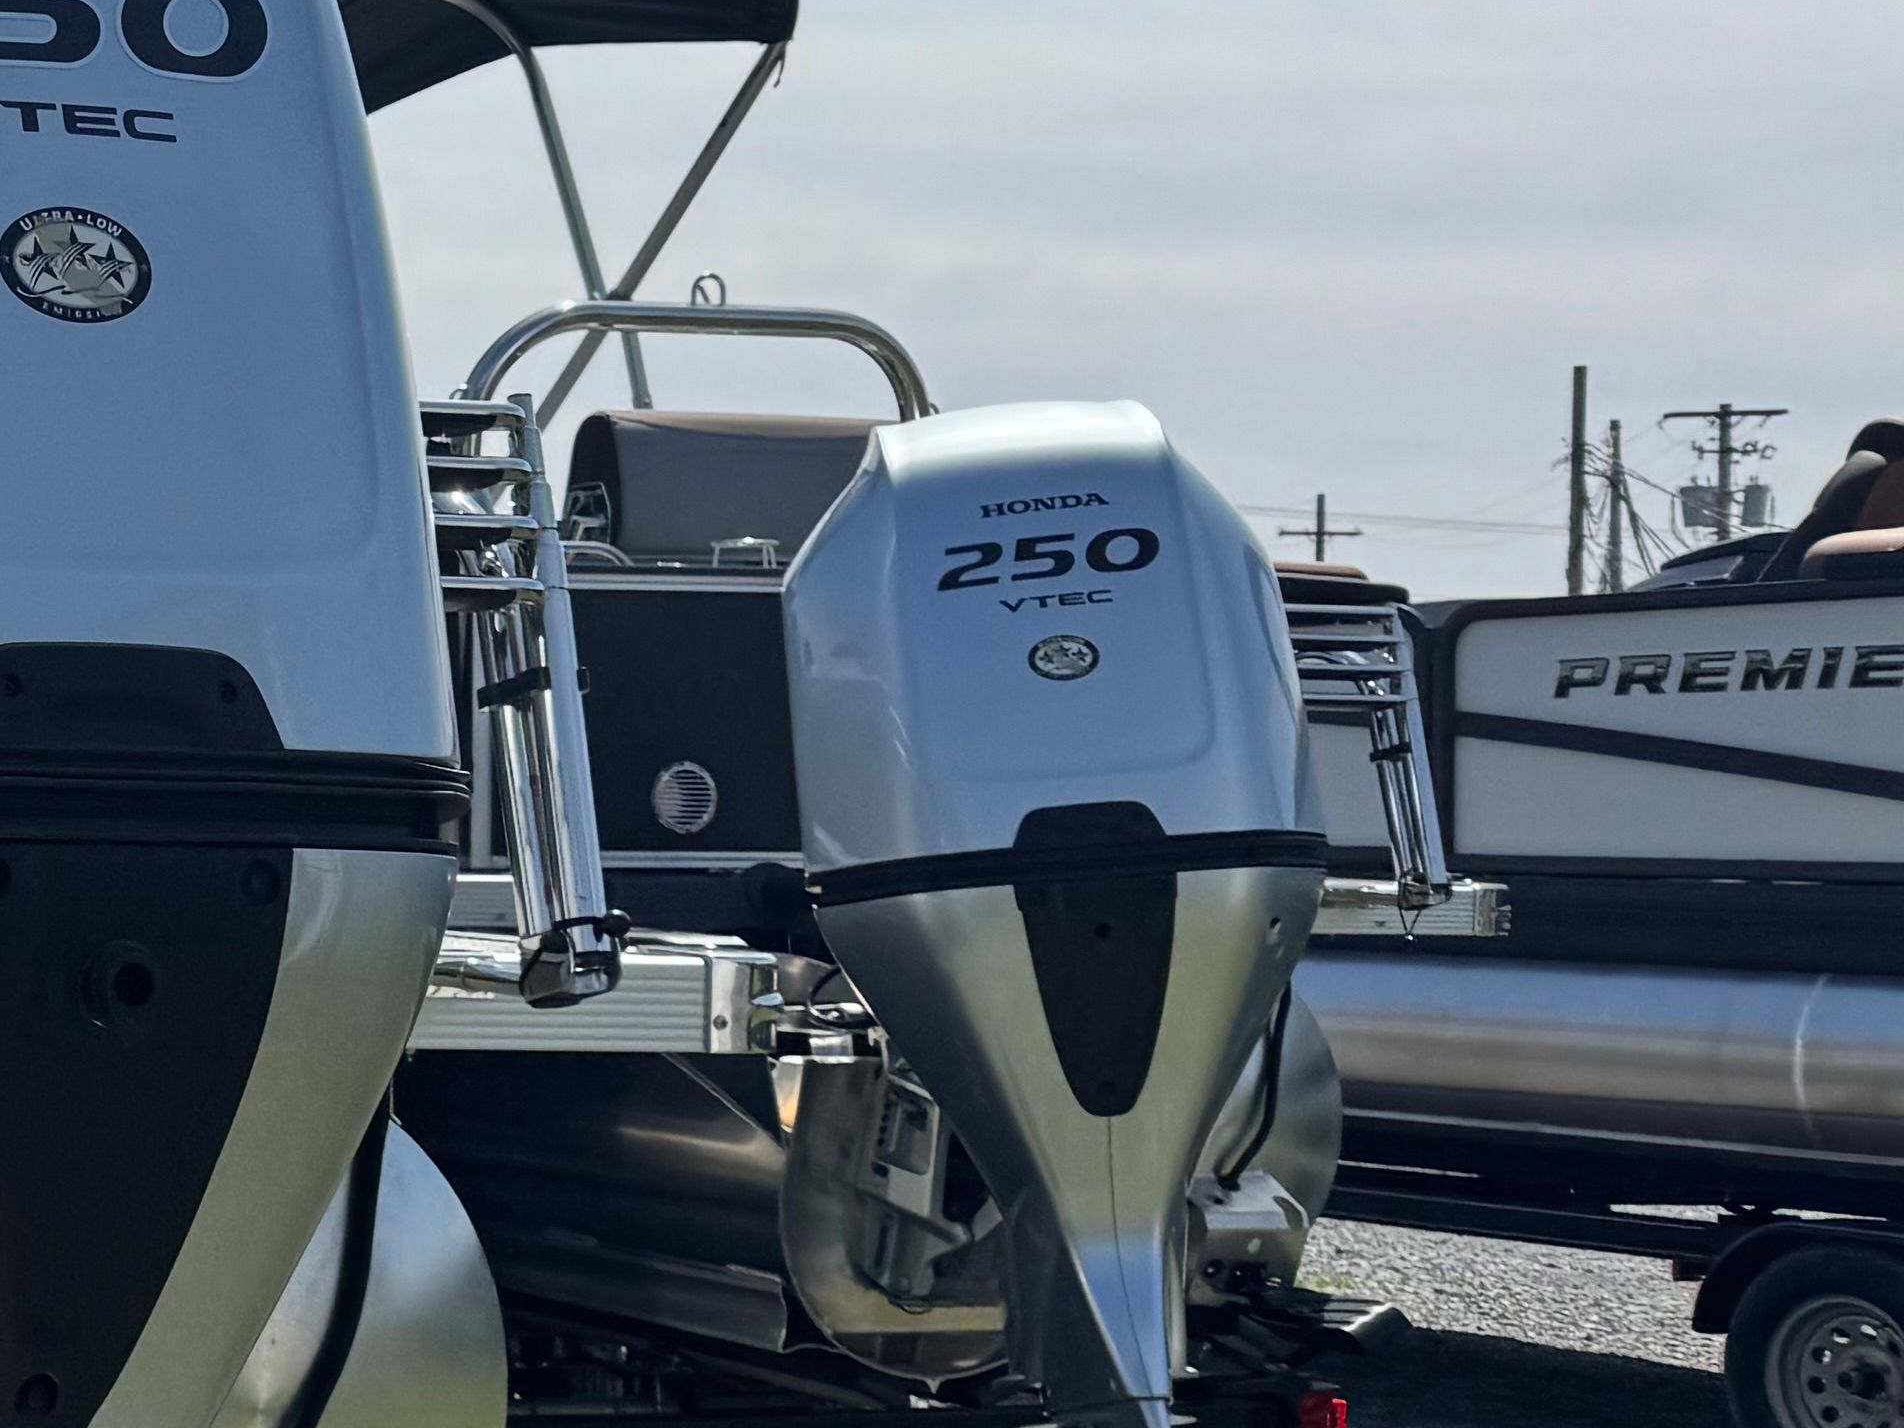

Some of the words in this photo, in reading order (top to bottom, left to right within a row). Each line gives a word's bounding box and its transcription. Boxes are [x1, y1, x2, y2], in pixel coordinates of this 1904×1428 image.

[979, 492, 1110, 519] HONDA
[936, 527, 1161, 592] 250
[998, 589, 1114, 613] VTEC
[1553, 644, 1904, 699] PREMIE
